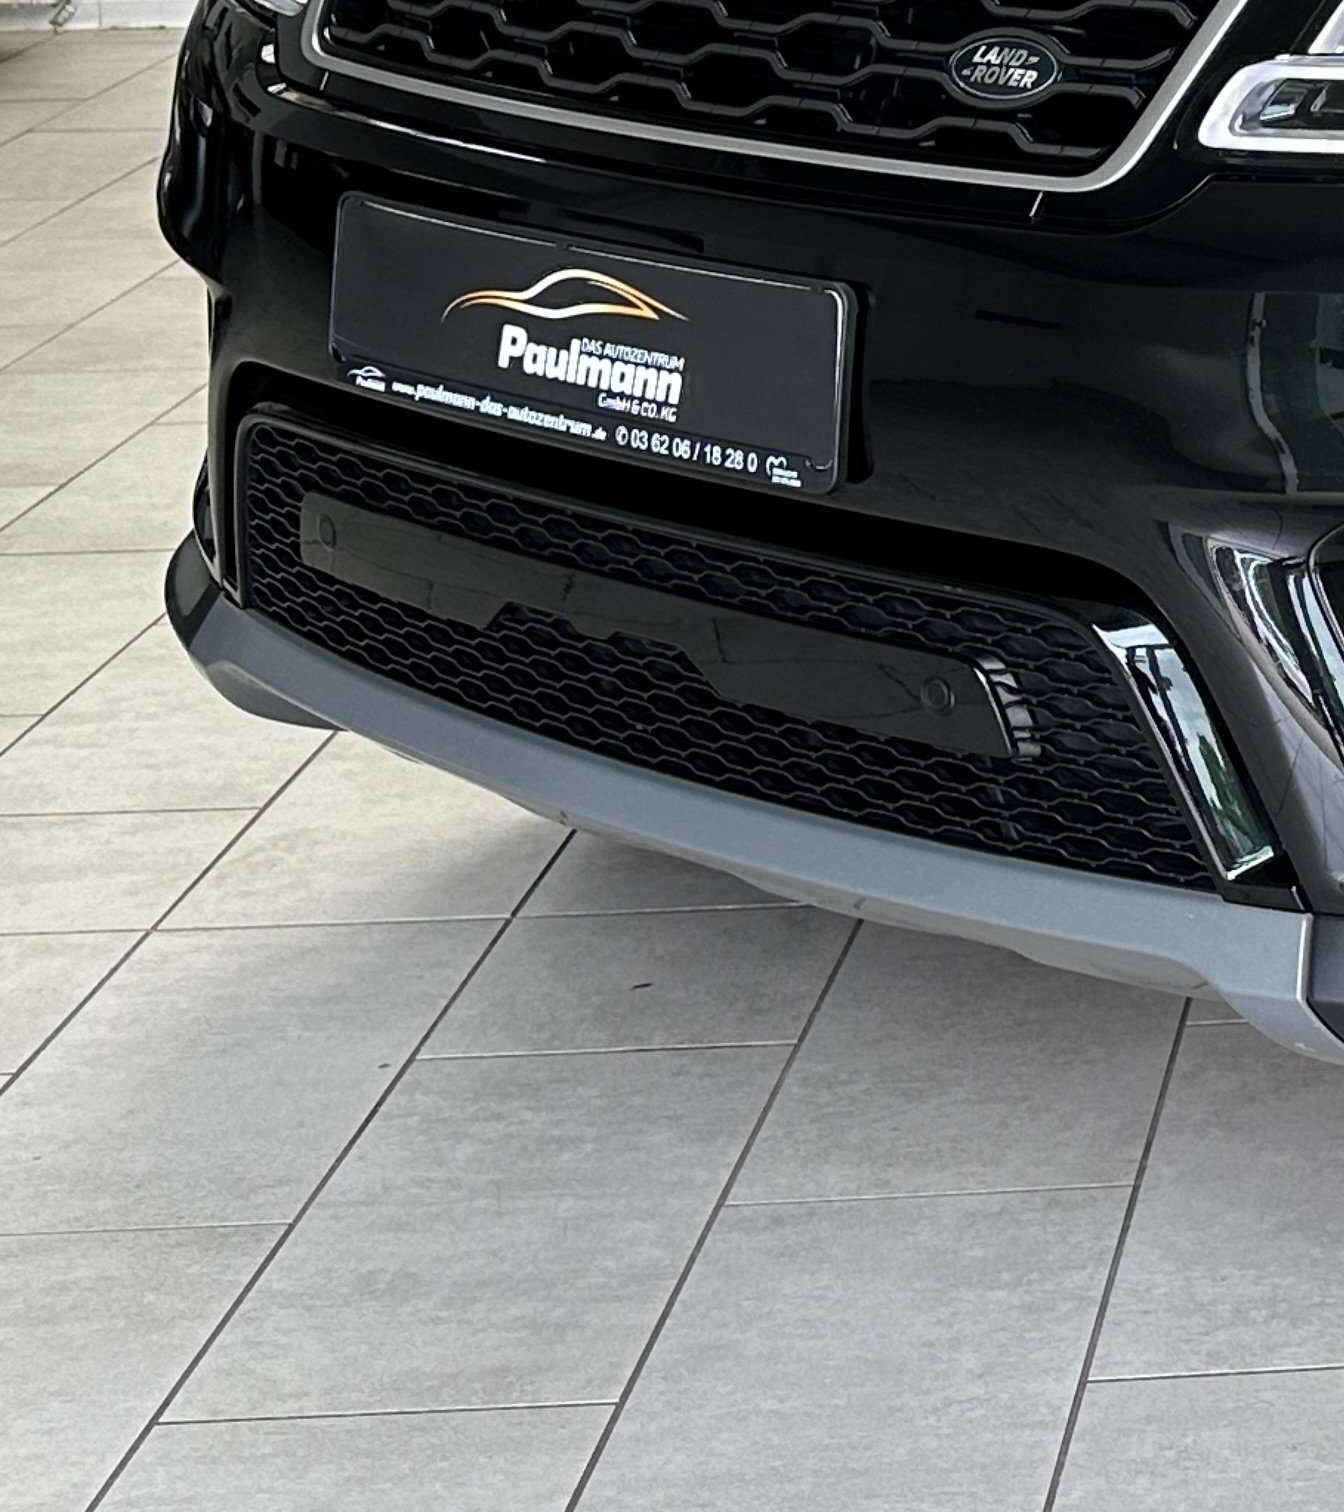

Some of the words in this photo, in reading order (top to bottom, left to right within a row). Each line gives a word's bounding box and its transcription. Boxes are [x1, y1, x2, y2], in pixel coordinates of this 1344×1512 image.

[971, 45, 1029, 67] LAND
[969, 64, 1039, 89] ROVER
[498, 323, 683, 405] Paulmann
[581, 337, 604, 355] DAS
[603, 342, 685, 372] AUTOZENTRUM
[660, 406, 678, 423] KG
[630, 428, 649, 450] 03
[651, 433, 669, 455] 62
[672, 437, 691, 460] 06
[704, 442, 721, 465] 18
[724, 447, 744, 470] 28
[747, 452, 758, 473] 0
